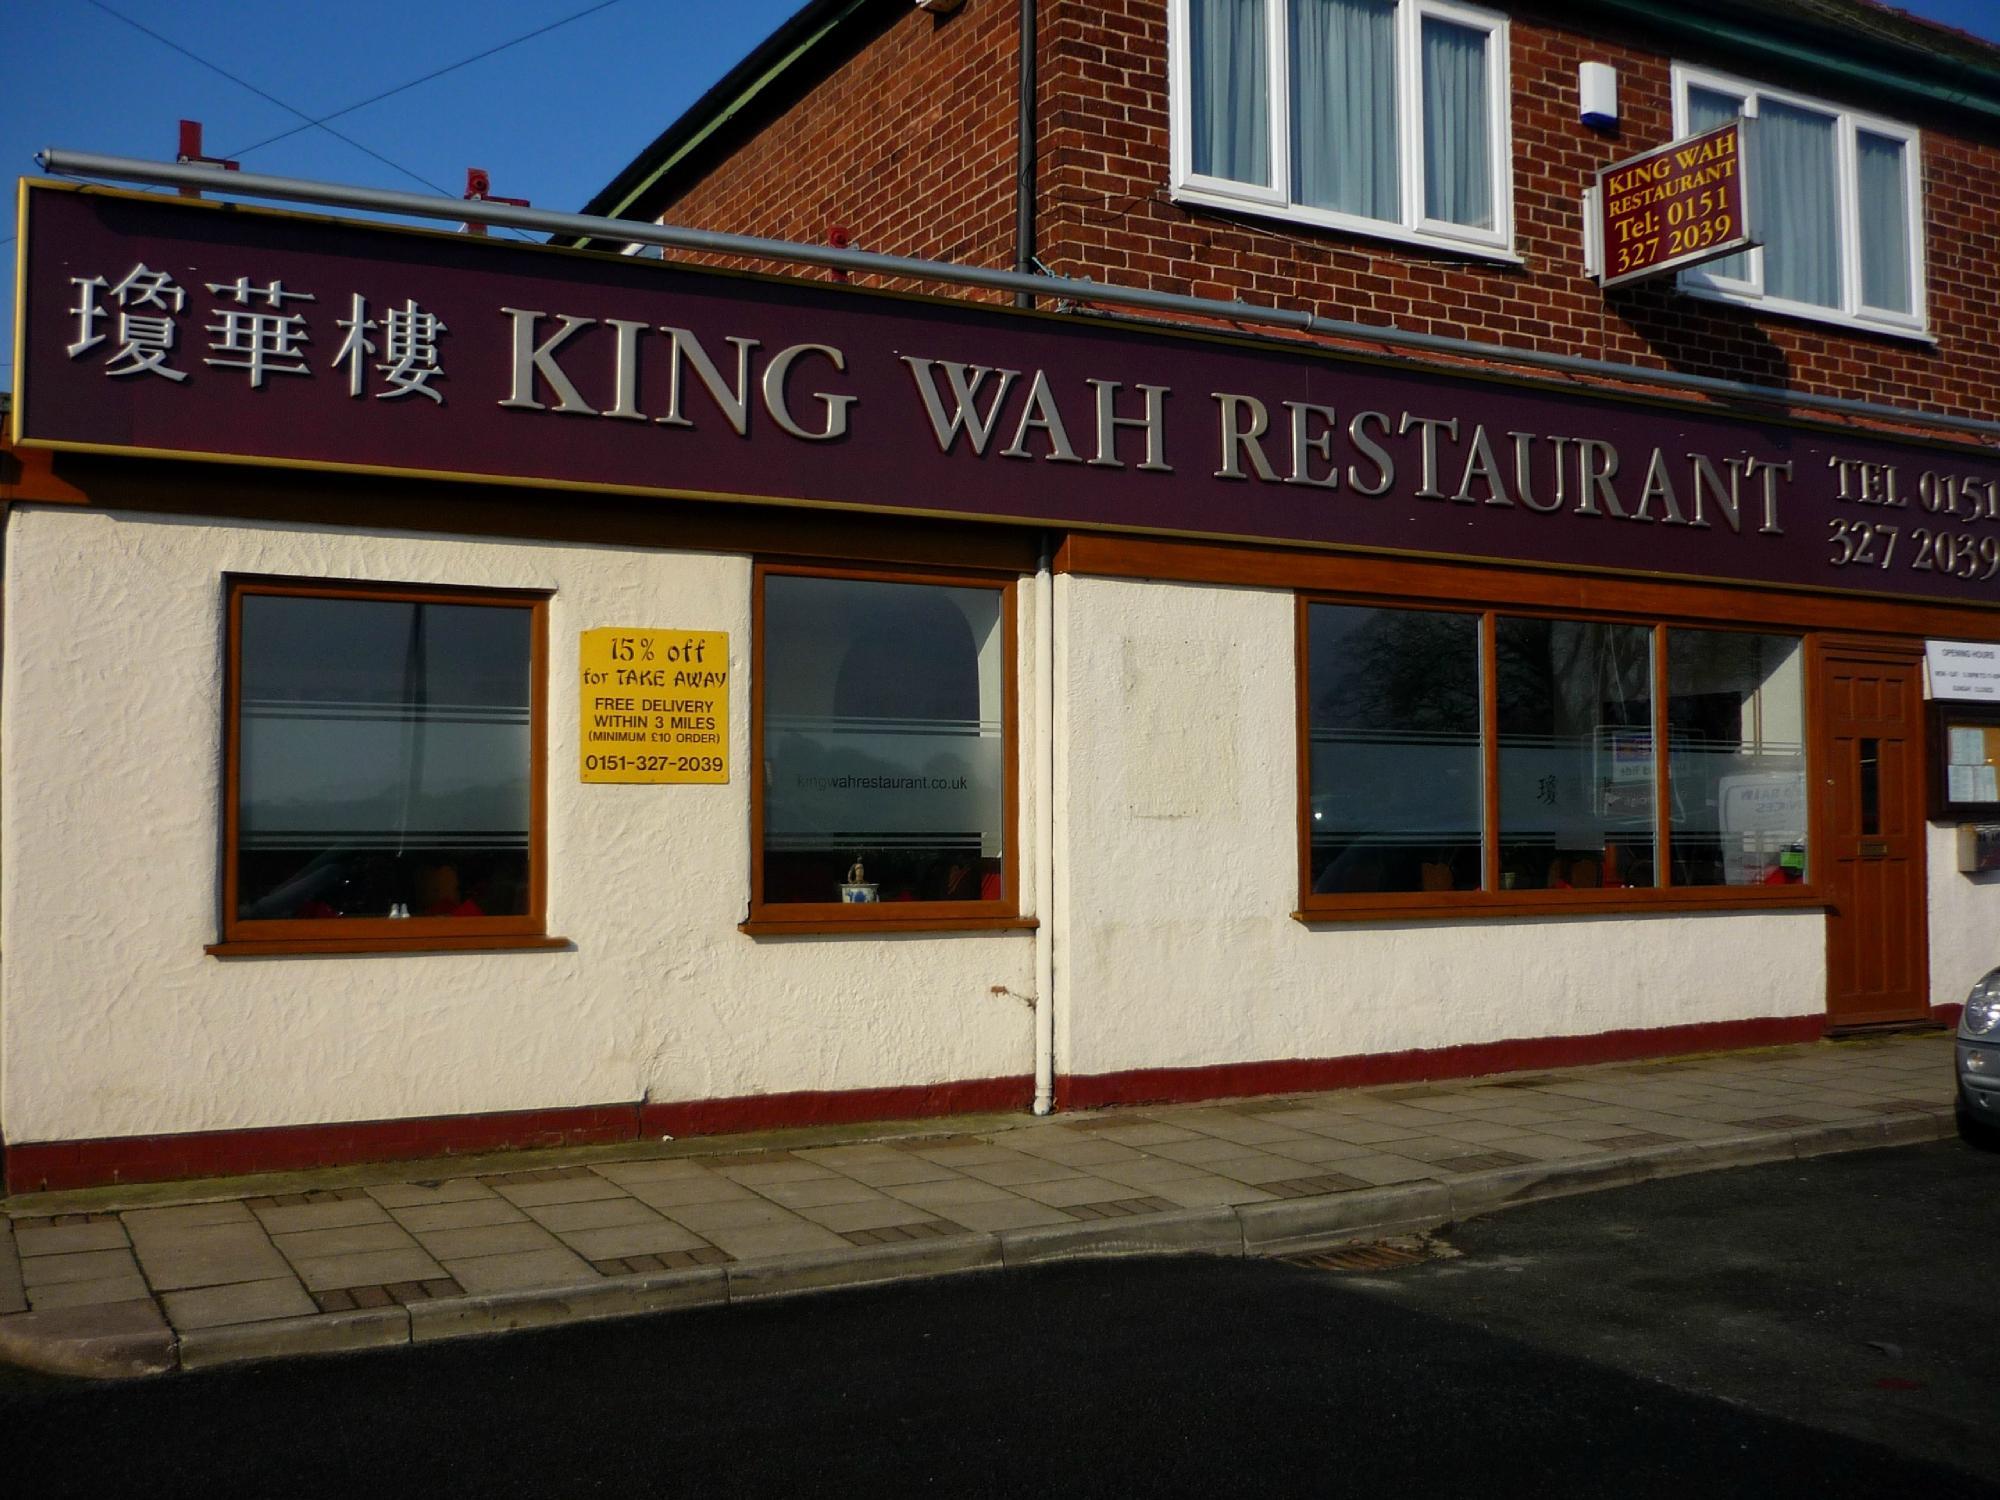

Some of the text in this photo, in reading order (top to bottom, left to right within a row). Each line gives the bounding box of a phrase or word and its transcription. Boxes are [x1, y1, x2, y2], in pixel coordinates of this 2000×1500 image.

[1609, 132, 1736, 197] KING WAH
[1609, 159, 1736, 218] RESTAURANT
[1615, 186, 1729, 243] Tel: 0151
[1618, 215, 1731, 273] 327 2039
[67, 262, 449, 405] 瓊華樓
[498, 307, 1793, 534] KING WAH RESTAURANT
[1828, 456, 2000, 522] TEL 0151
[1828, 518, 2000, 580] 327 2039
[583, 668, 726, 688] for TAKE AWAY
[667, 638, 706, 663] off
[594, 714, 715, 730] WITHIN 3 MILES
[595, 697, 714, 713] FREE DELIVERY
[585, 754, 723, 772] 0151-327-2039
[588, 731, 720, 744] (MINIMUM £10 ORDER)
